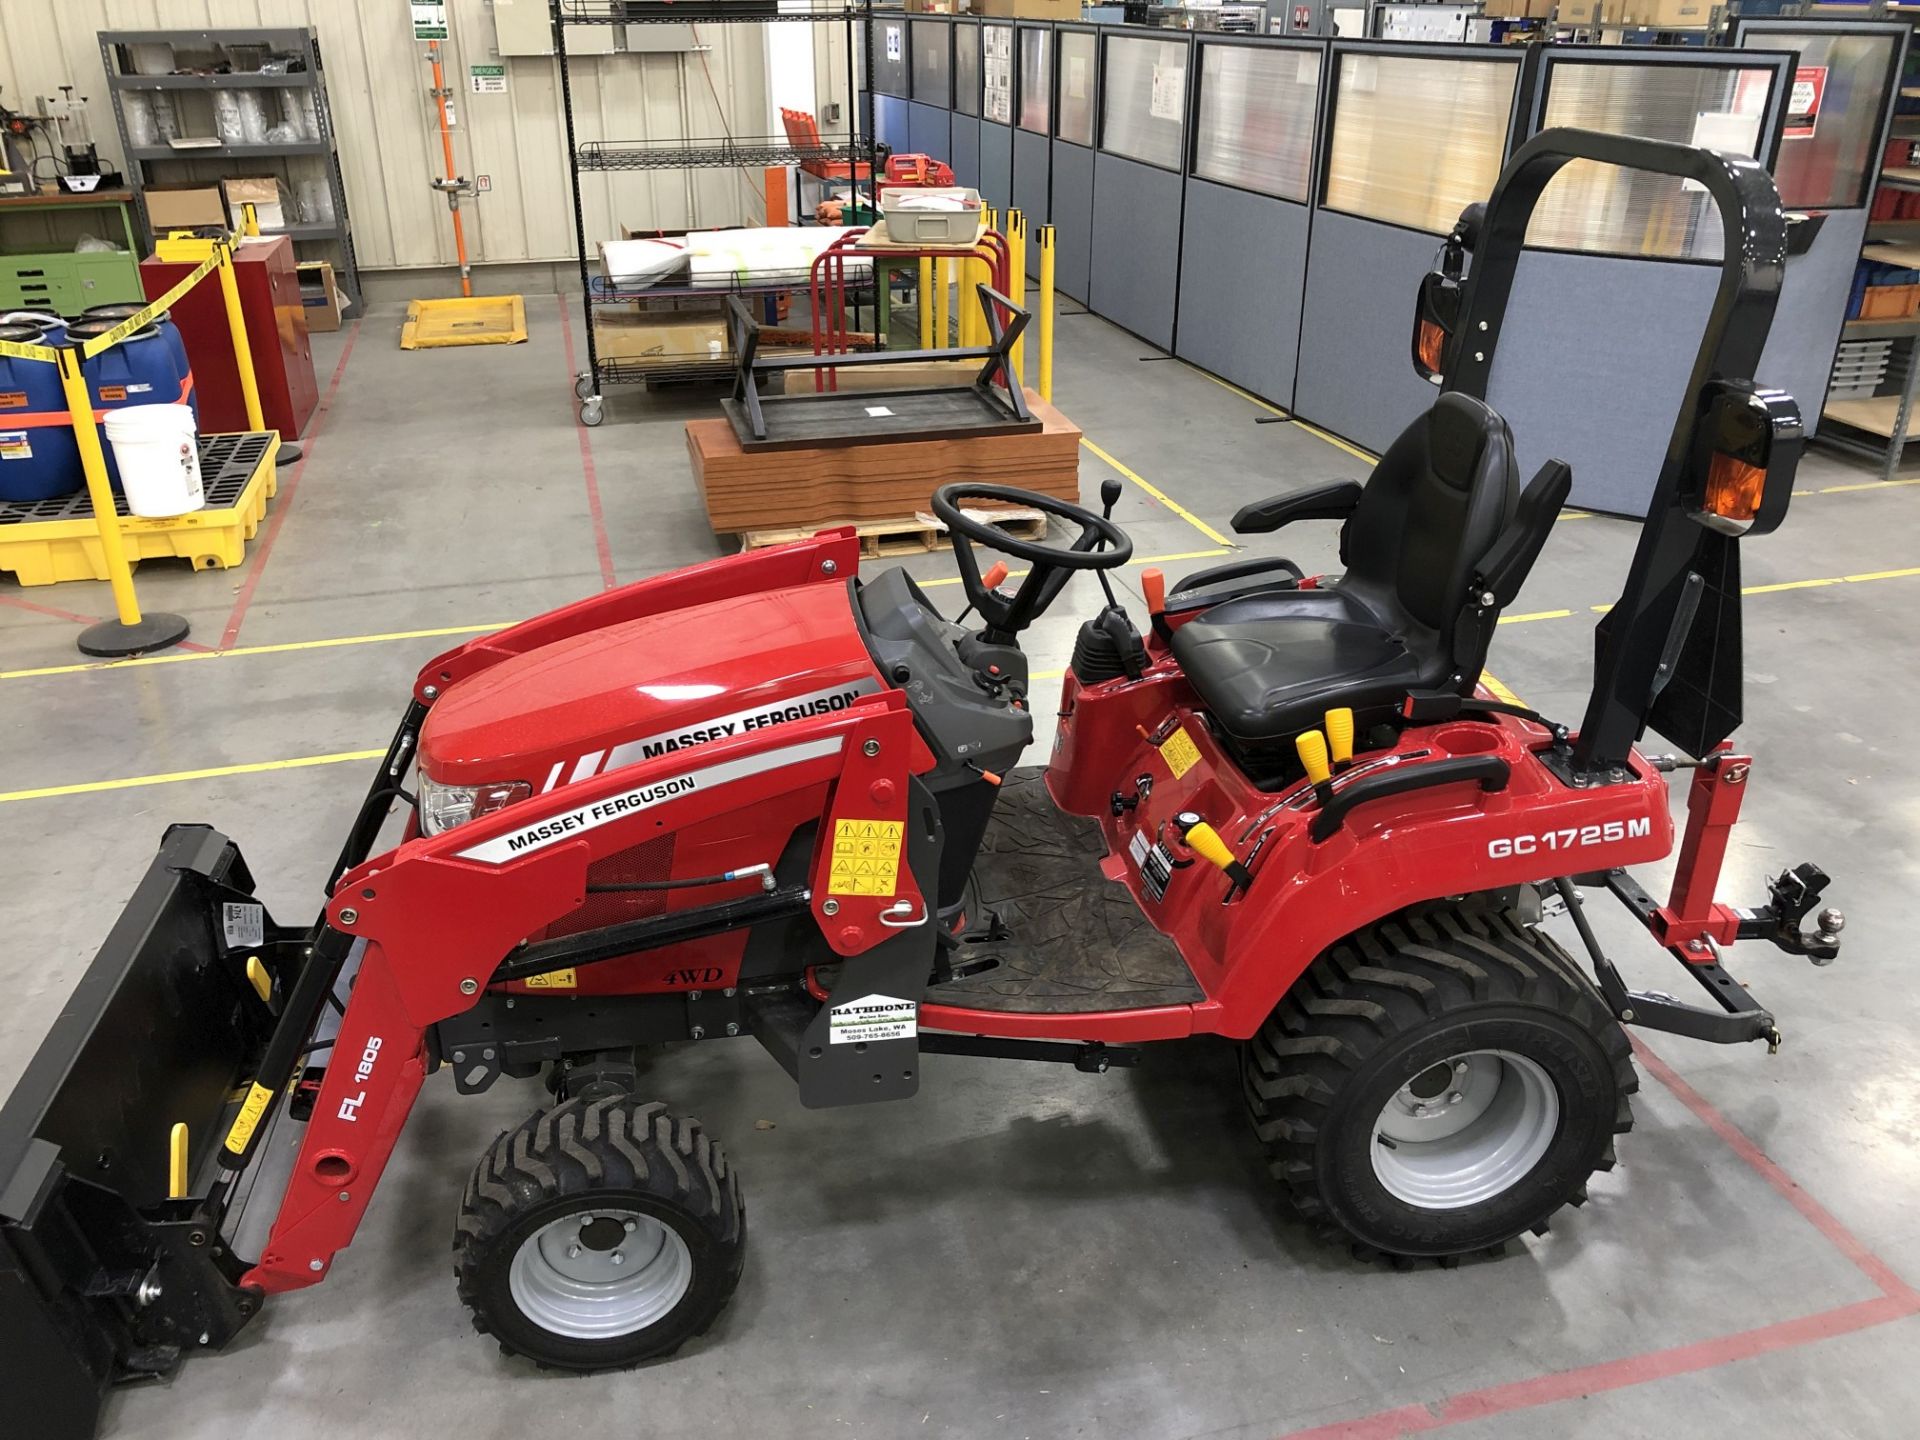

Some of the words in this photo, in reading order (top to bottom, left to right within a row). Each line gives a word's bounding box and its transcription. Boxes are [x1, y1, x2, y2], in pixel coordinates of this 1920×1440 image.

[109, 325, 126, 342] CAUTION
[128, 319, 135, 331] DO
[134, 313, 142, 326] NOT
[141, 307, 152, 323] ENTER
[642, 722, 736, 760] MASSEY
[508, 812, 585, 851] MASSEY
[592, 776, 696, 820] FERGUSON
[662, 967, 723, 985] 4WD
[831, 1003, 916, 1016] RATHBONE
[337, 1091, 368, 1122] FL
[354, 1036, 383, 1083] 1805
